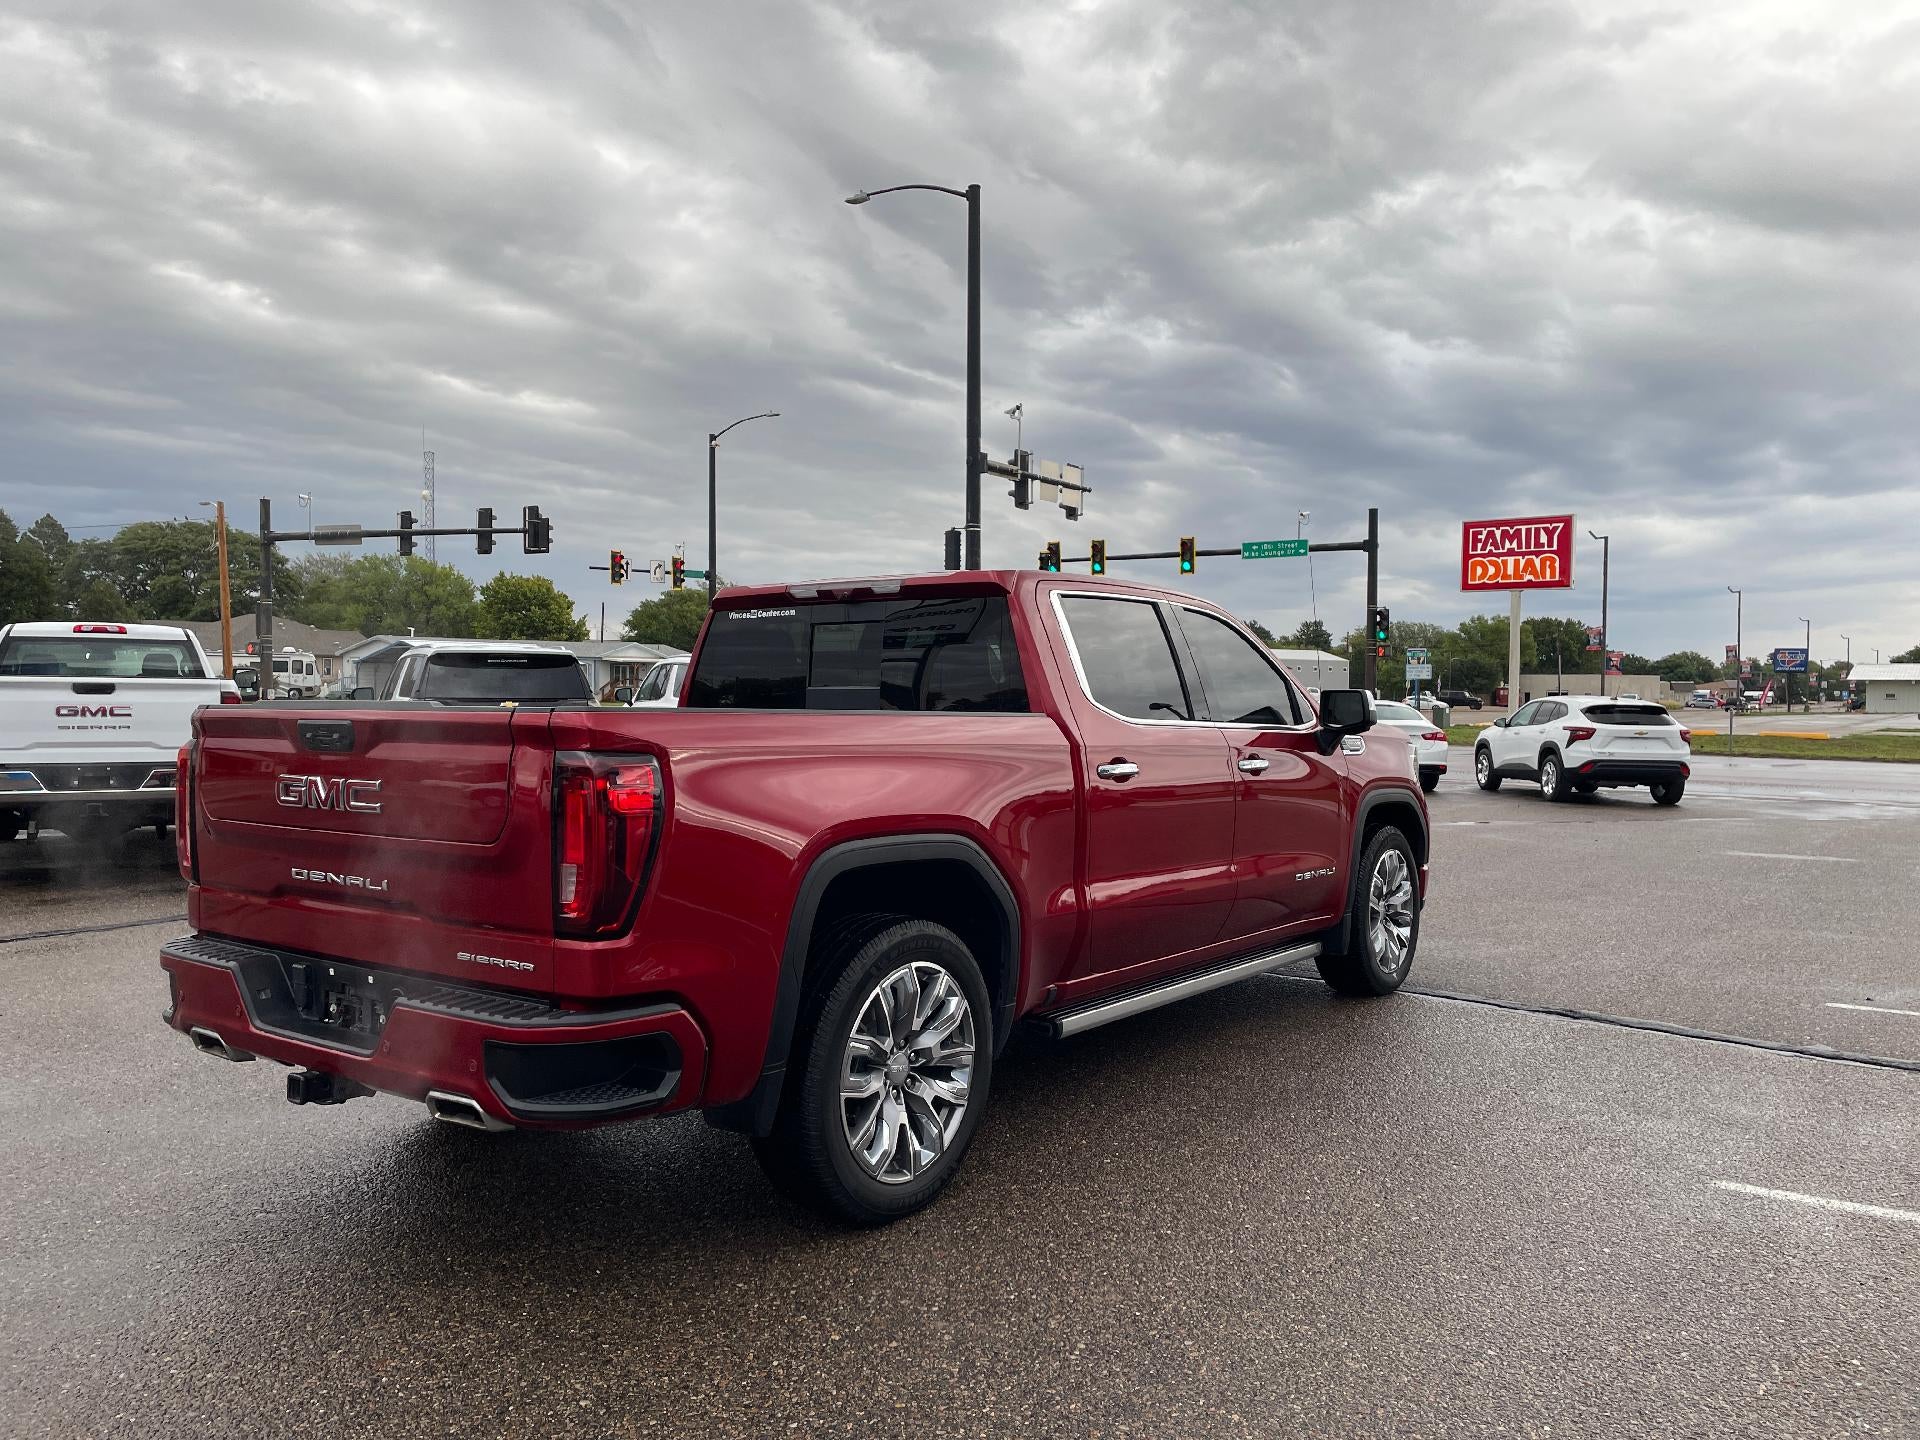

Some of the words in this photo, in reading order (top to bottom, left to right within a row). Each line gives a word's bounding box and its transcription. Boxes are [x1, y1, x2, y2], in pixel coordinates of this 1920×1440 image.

[1468, 523, 1565, 554] FAMILY
[1467, 554, 1560, 584] DOLLAR
[56, 705, 132, 717] GMC
[275, 773, 384, 814] GMC
[291, 867, 389, 891] DENALI
[1295, 866, 1336, 881] DENALI
[456, 951, 536, 972] SIERRA
